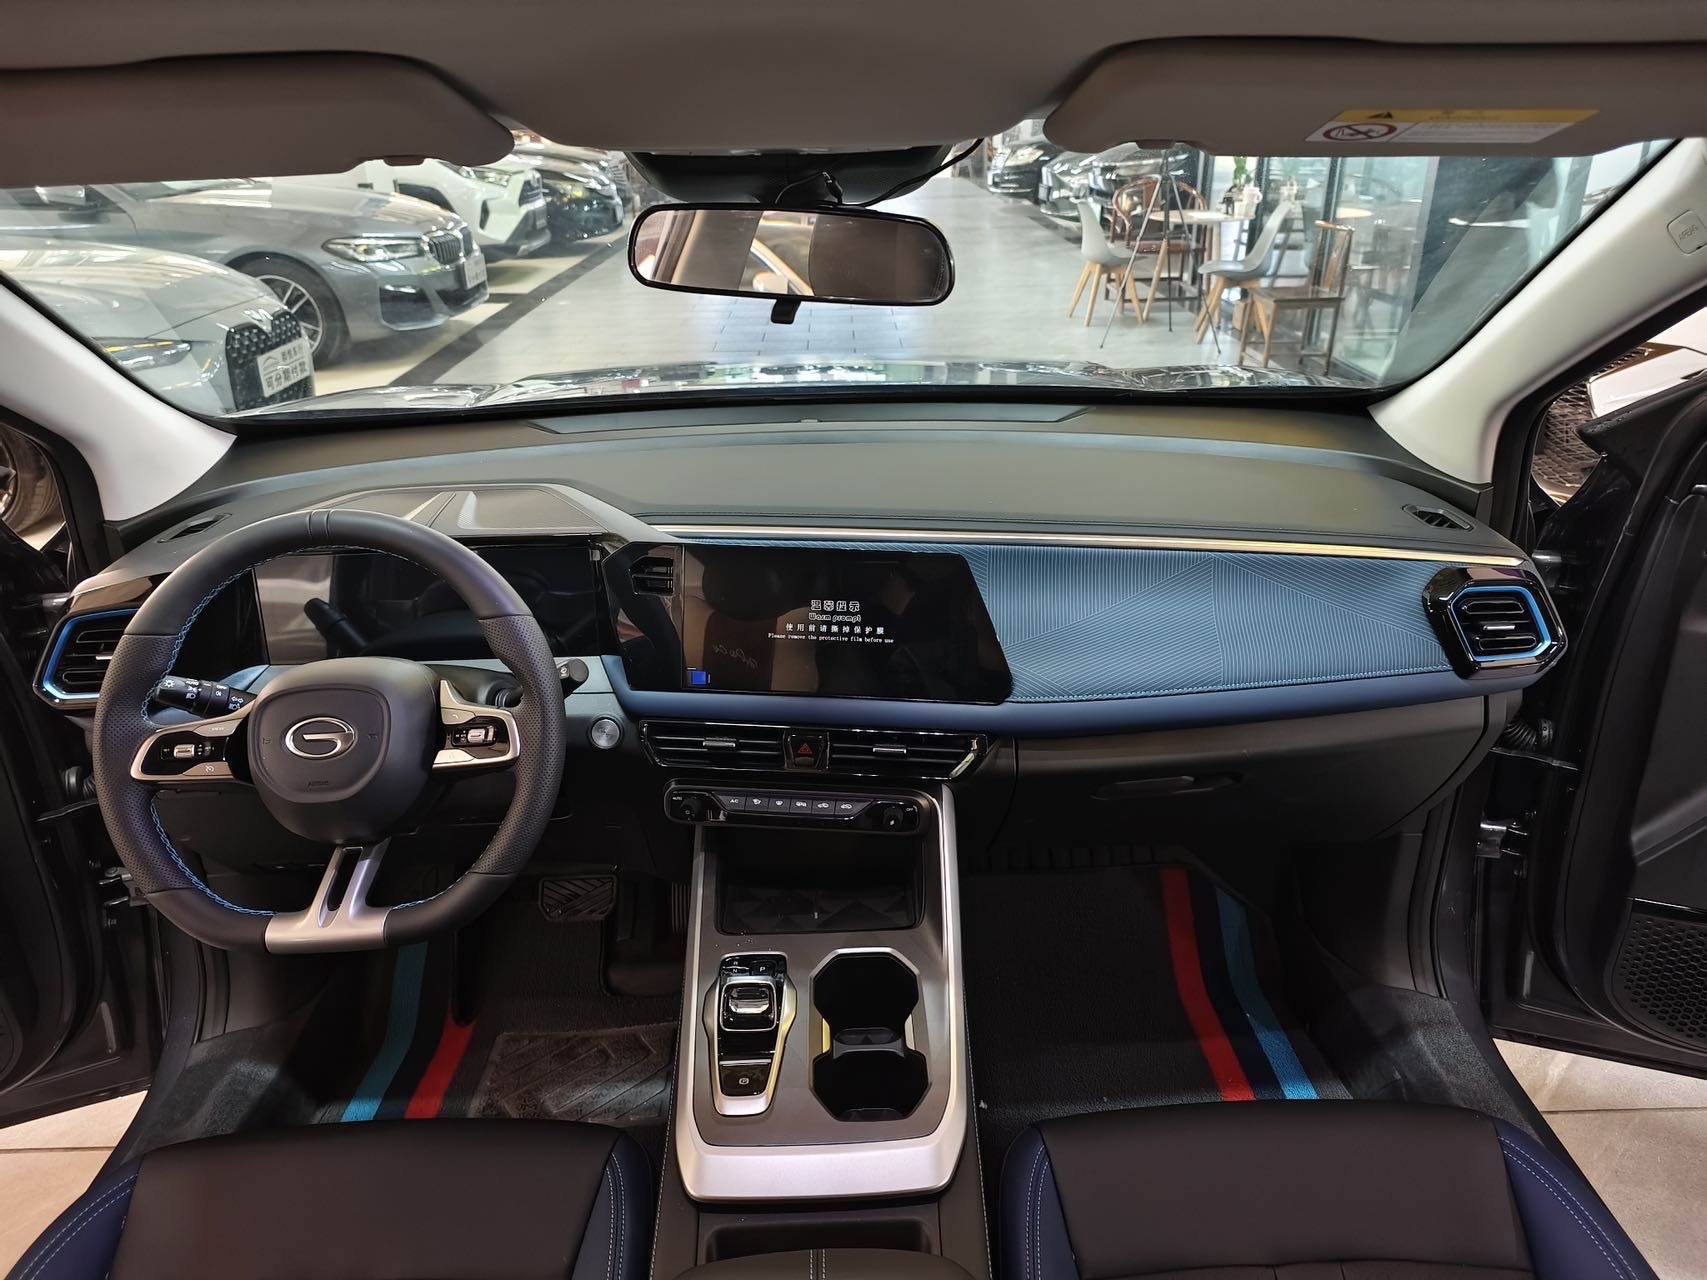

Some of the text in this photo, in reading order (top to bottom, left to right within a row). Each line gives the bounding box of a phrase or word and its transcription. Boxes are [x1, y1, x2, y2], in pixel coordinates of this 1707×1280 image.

[811, 600, 860, 612] 温馨提示
[809, 612, 862, 623] Warm prompt
[786, 623, 884, 635] 使用前请撕掉保护膜
